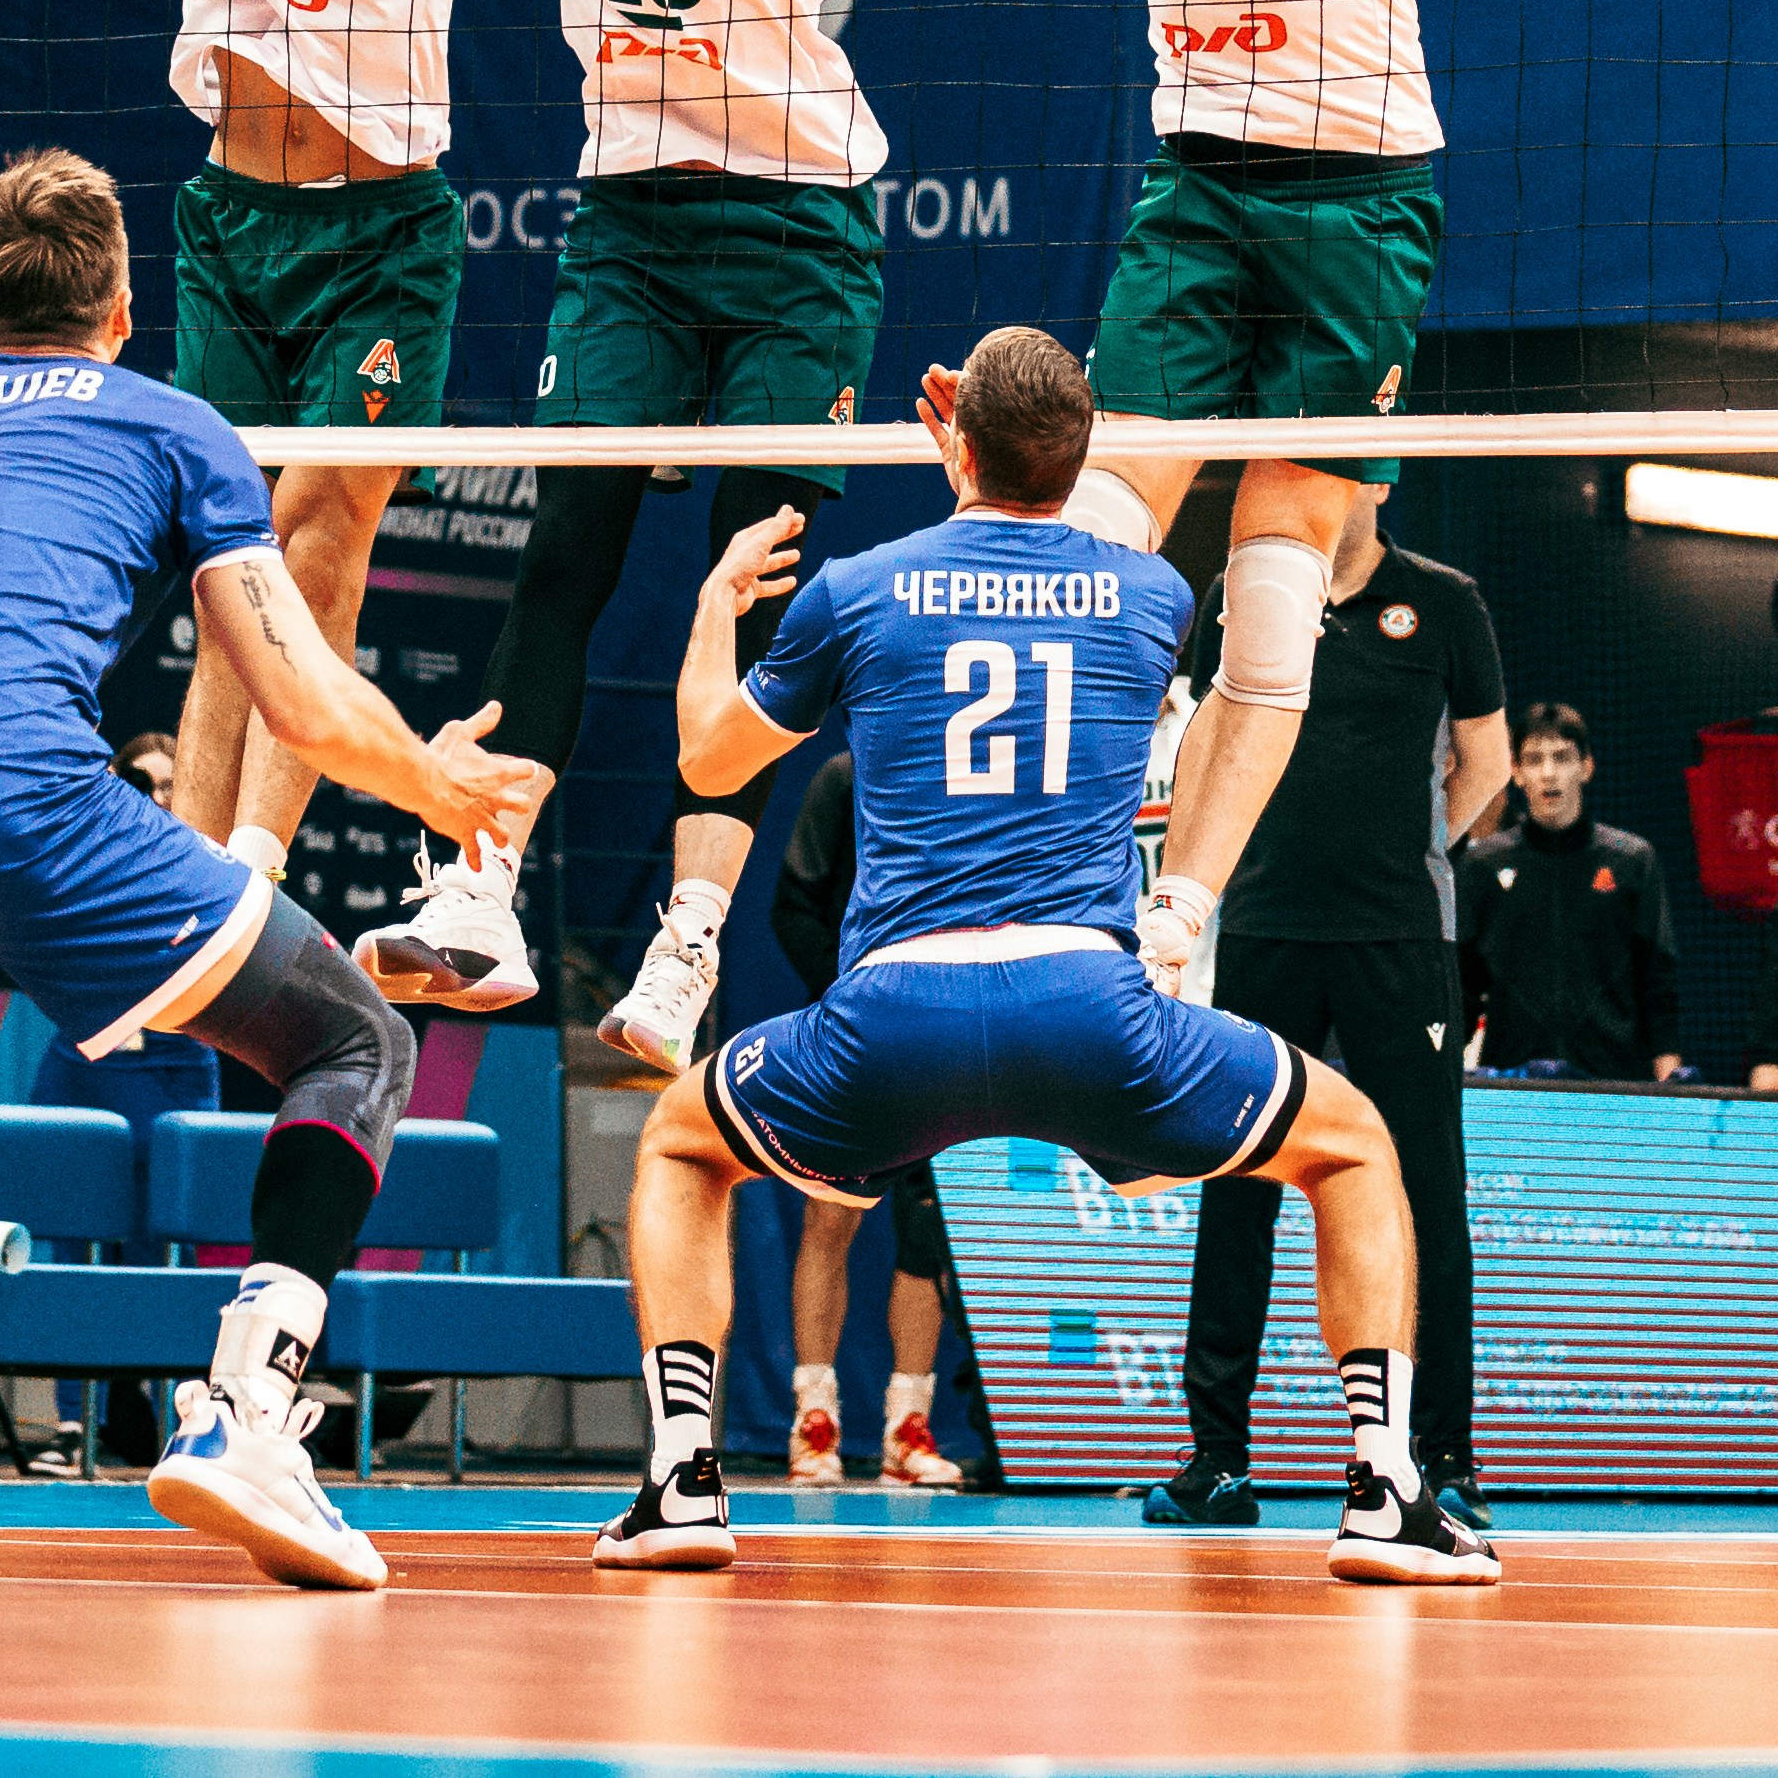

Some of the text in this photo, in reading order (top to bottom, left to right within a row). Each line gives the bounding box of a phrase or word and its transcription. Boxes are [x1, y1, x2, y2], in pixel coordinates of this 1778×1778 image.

[893, 570, 1120, 618] ЧЕРВЯКОВ
[944, 639, 1074, 796] 21
[734, 1036, 766, 1086] 21
